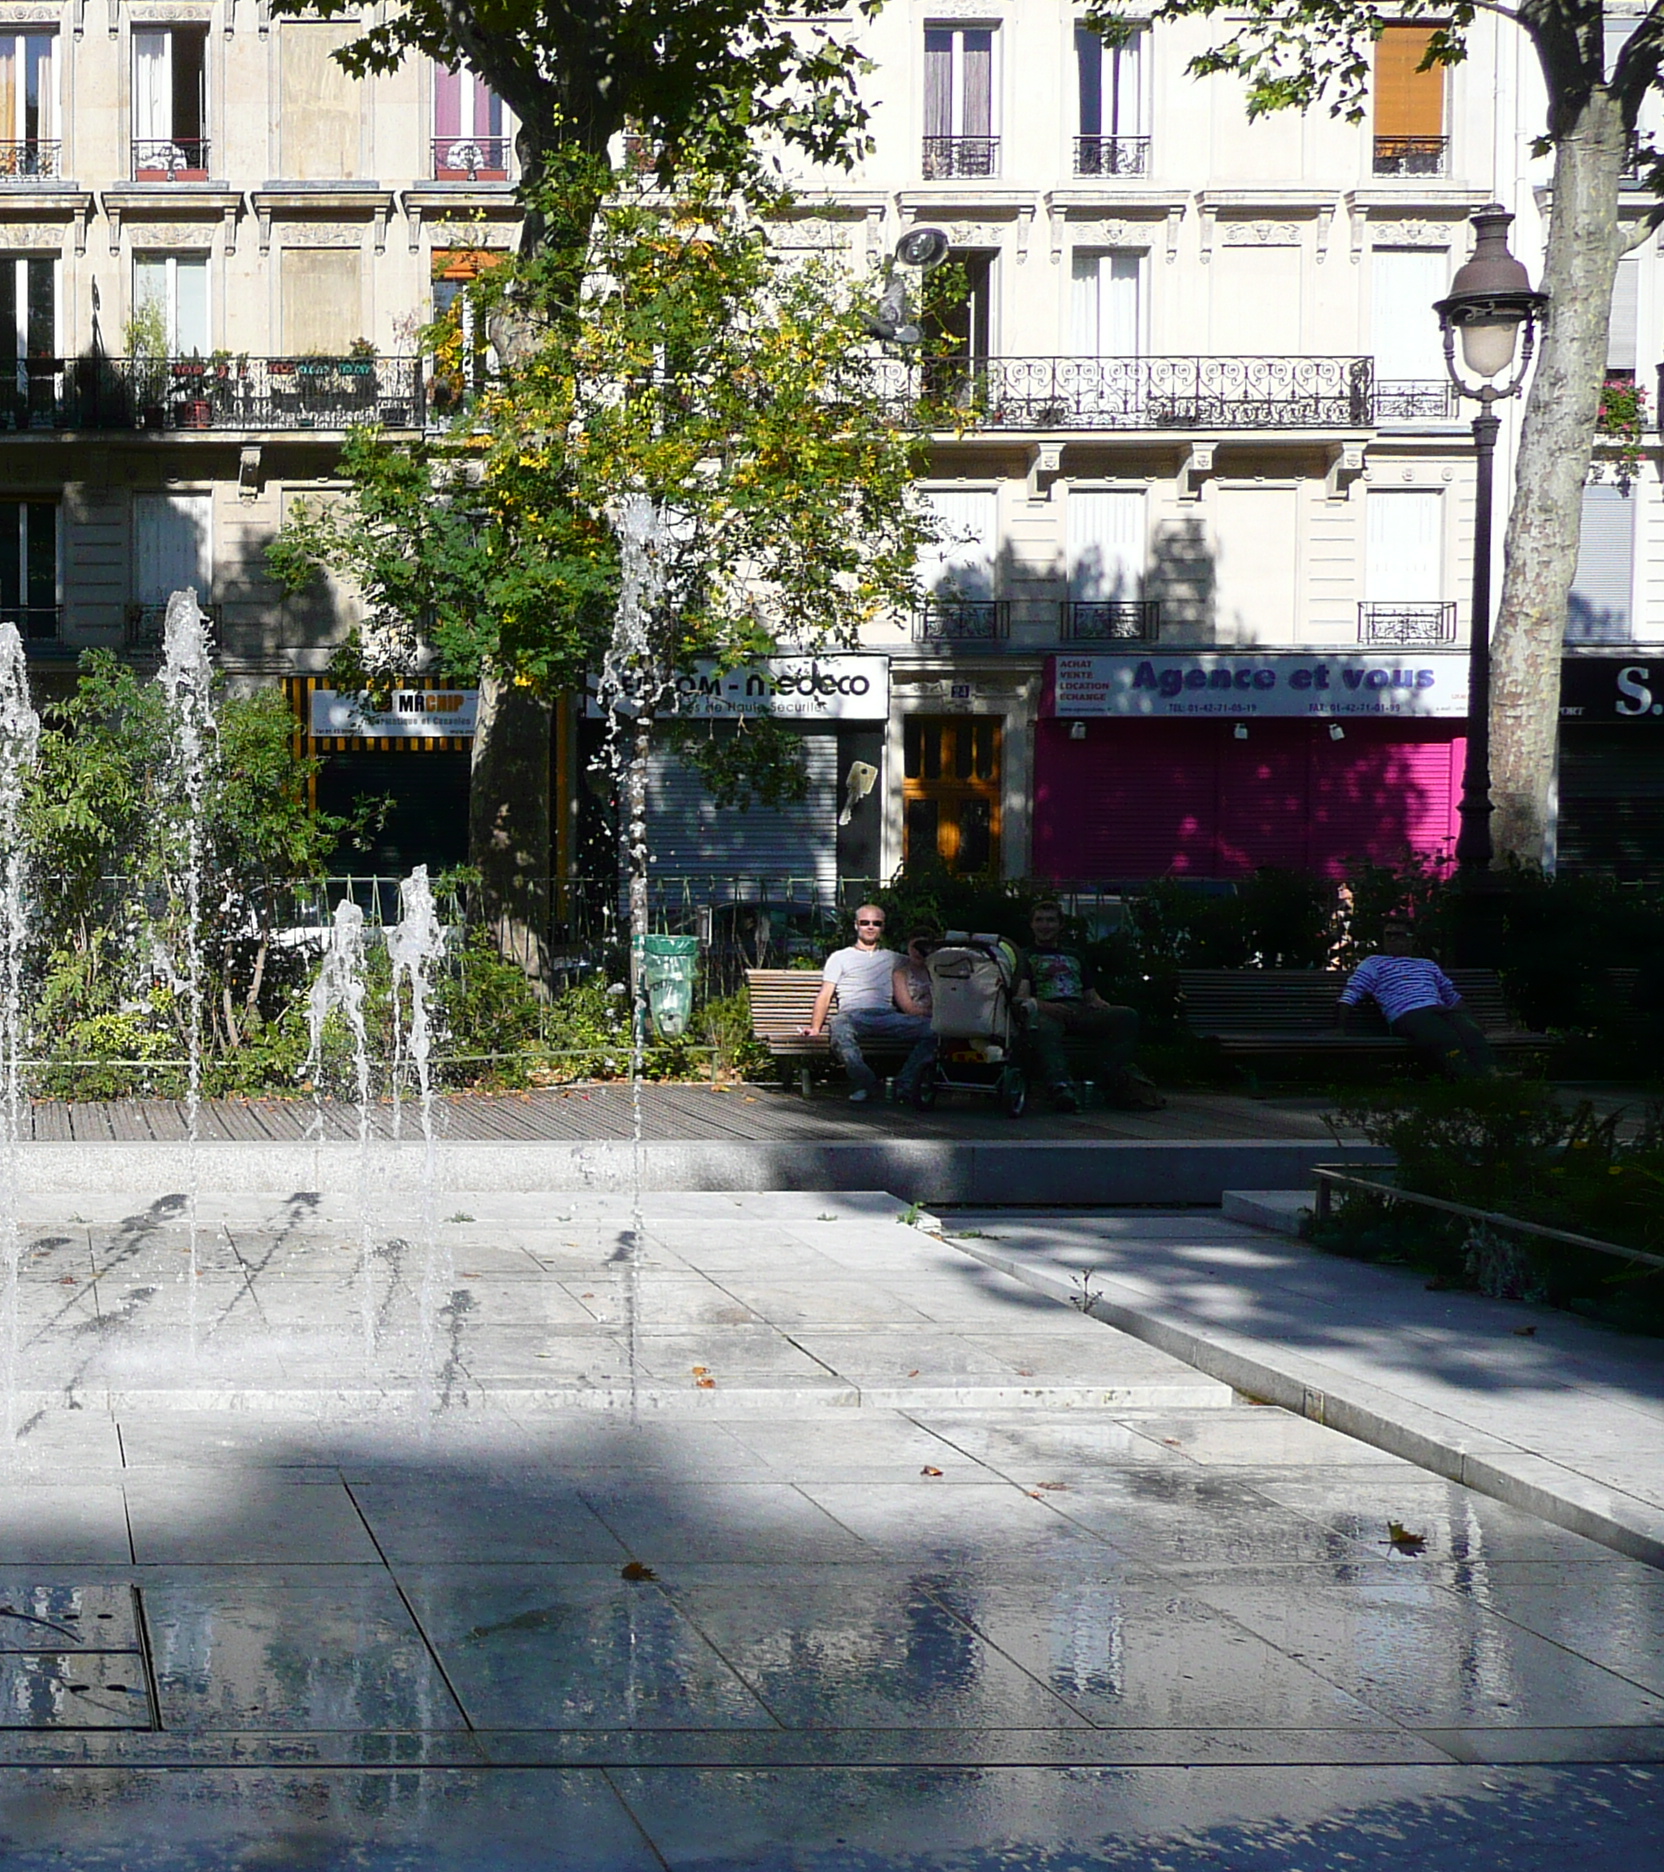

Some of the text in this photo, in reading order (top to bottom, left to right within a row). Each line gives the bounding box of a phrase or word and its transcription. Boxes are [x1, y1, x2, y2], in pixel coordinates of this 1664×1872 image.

[1060, 660, 1092, 668] ACHAT
[1060, 671, 1093, 679] VENTE
[1132, 660, 1435, 697] Agence et vous
[1060, 682, 1110, 690] LOCATION
